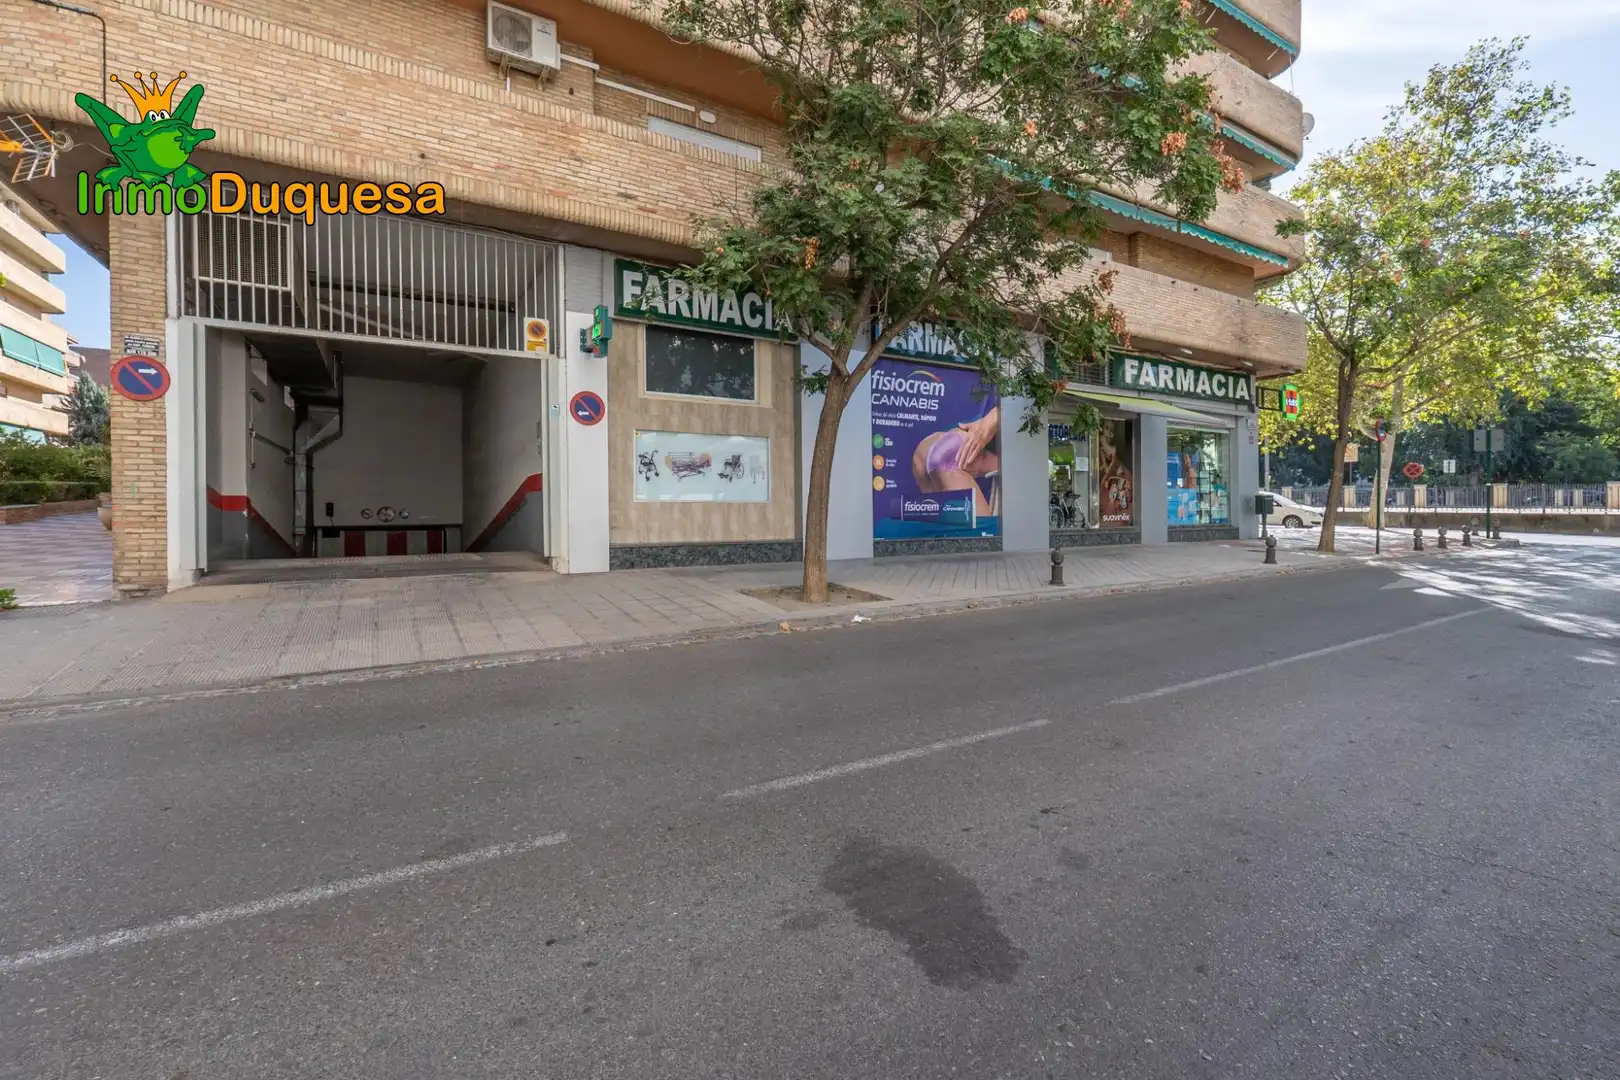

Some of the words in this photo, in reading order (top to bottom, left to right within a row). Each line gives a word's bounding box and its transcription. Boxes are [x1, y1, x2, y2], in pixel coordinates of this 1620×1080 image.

[871, 369, 946, 397] fisiocrem
[1124, 358, 1250, 400] FARMACIA
[871, 393, 940, 411] CANNABIS
[904, 501, 940, 512] fisiocrem
